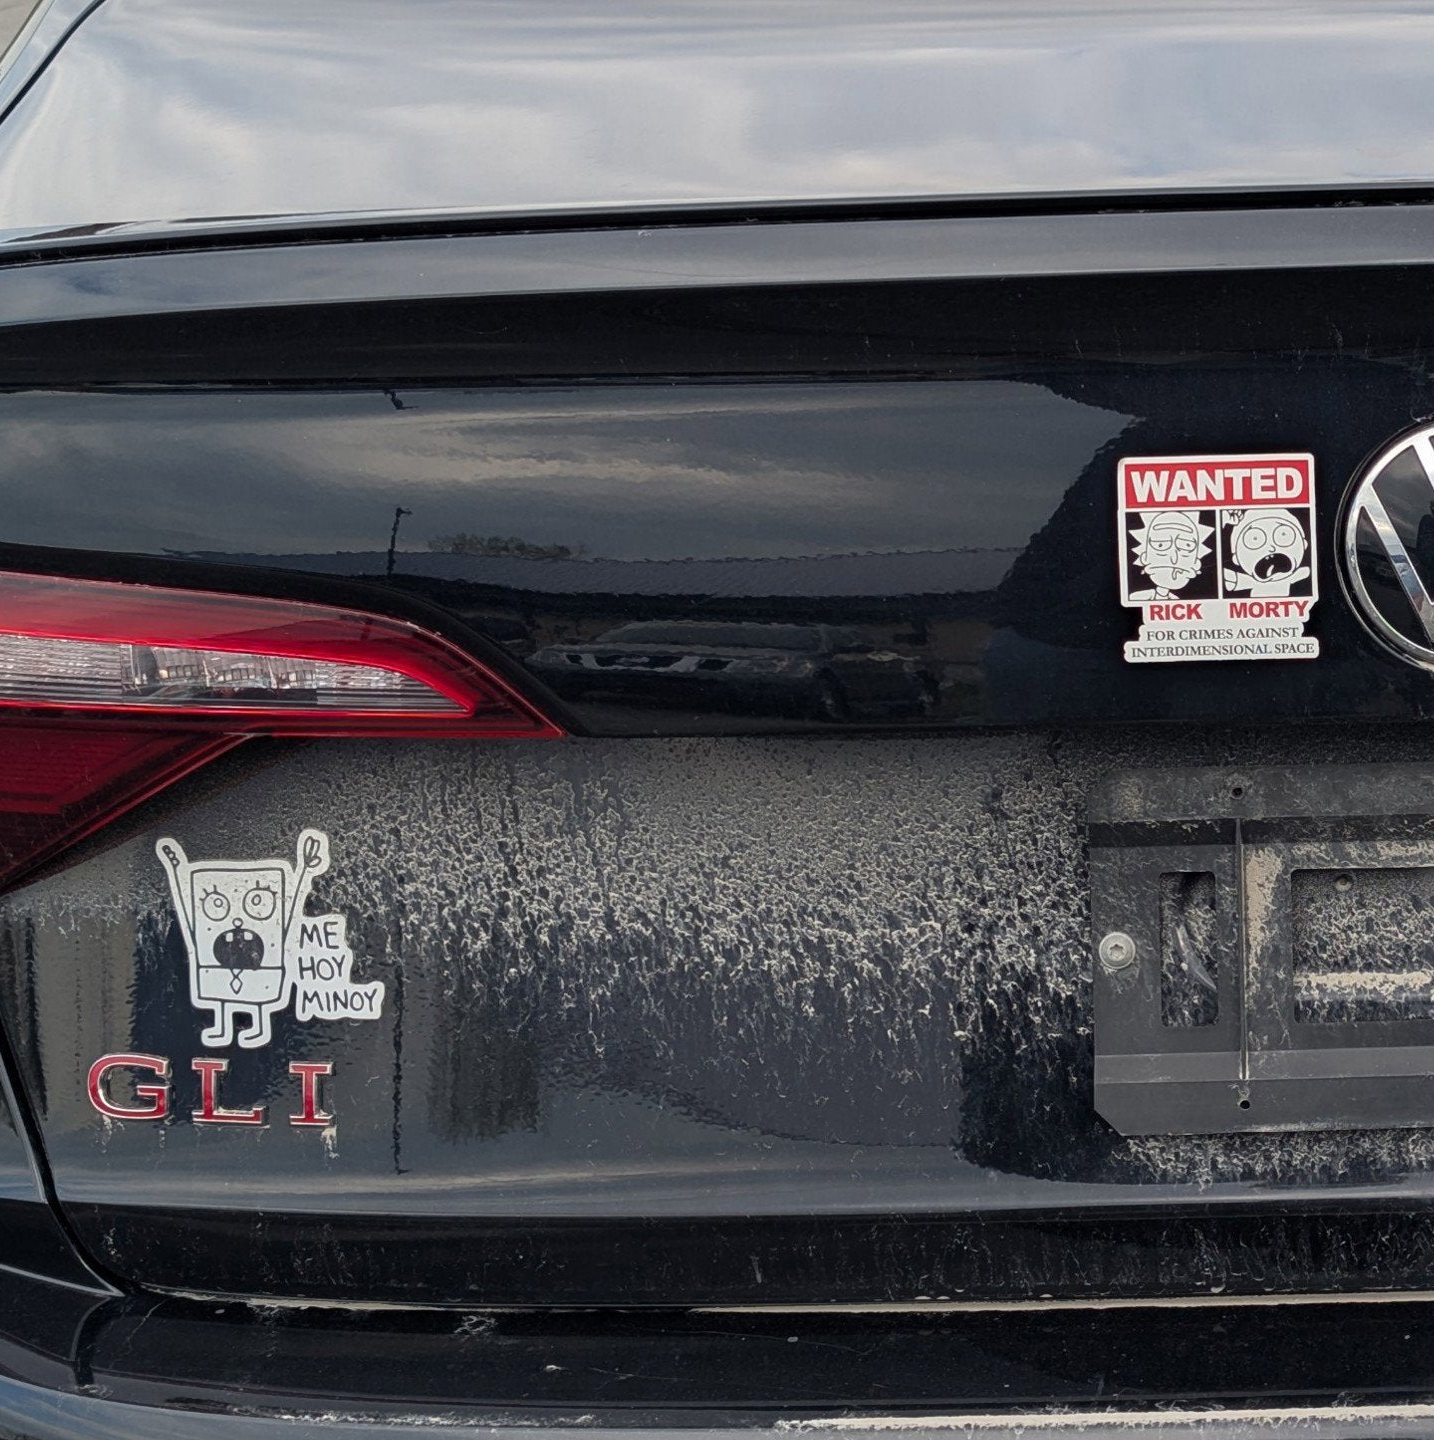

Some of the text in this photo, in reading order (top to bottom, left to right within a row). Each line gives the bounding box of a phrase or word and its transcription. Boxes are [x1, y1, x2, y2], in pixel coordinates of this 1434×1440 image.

[1130, 466, 1304, 504] WANTED
[1149, 600, 1309, 621] RICK MORTY
[1147, 626, 1300, 642] FOR CRIMES AGAINST
[1131, 643, 1315, 658] INTERDIMENSIONAL SPACE
[299, 921, 339, 950] ME
[298, 955, 346, 981] HOY
[302, 989, 378, 1013] MINOY
[87, 1054, 333, 1127] GLI
